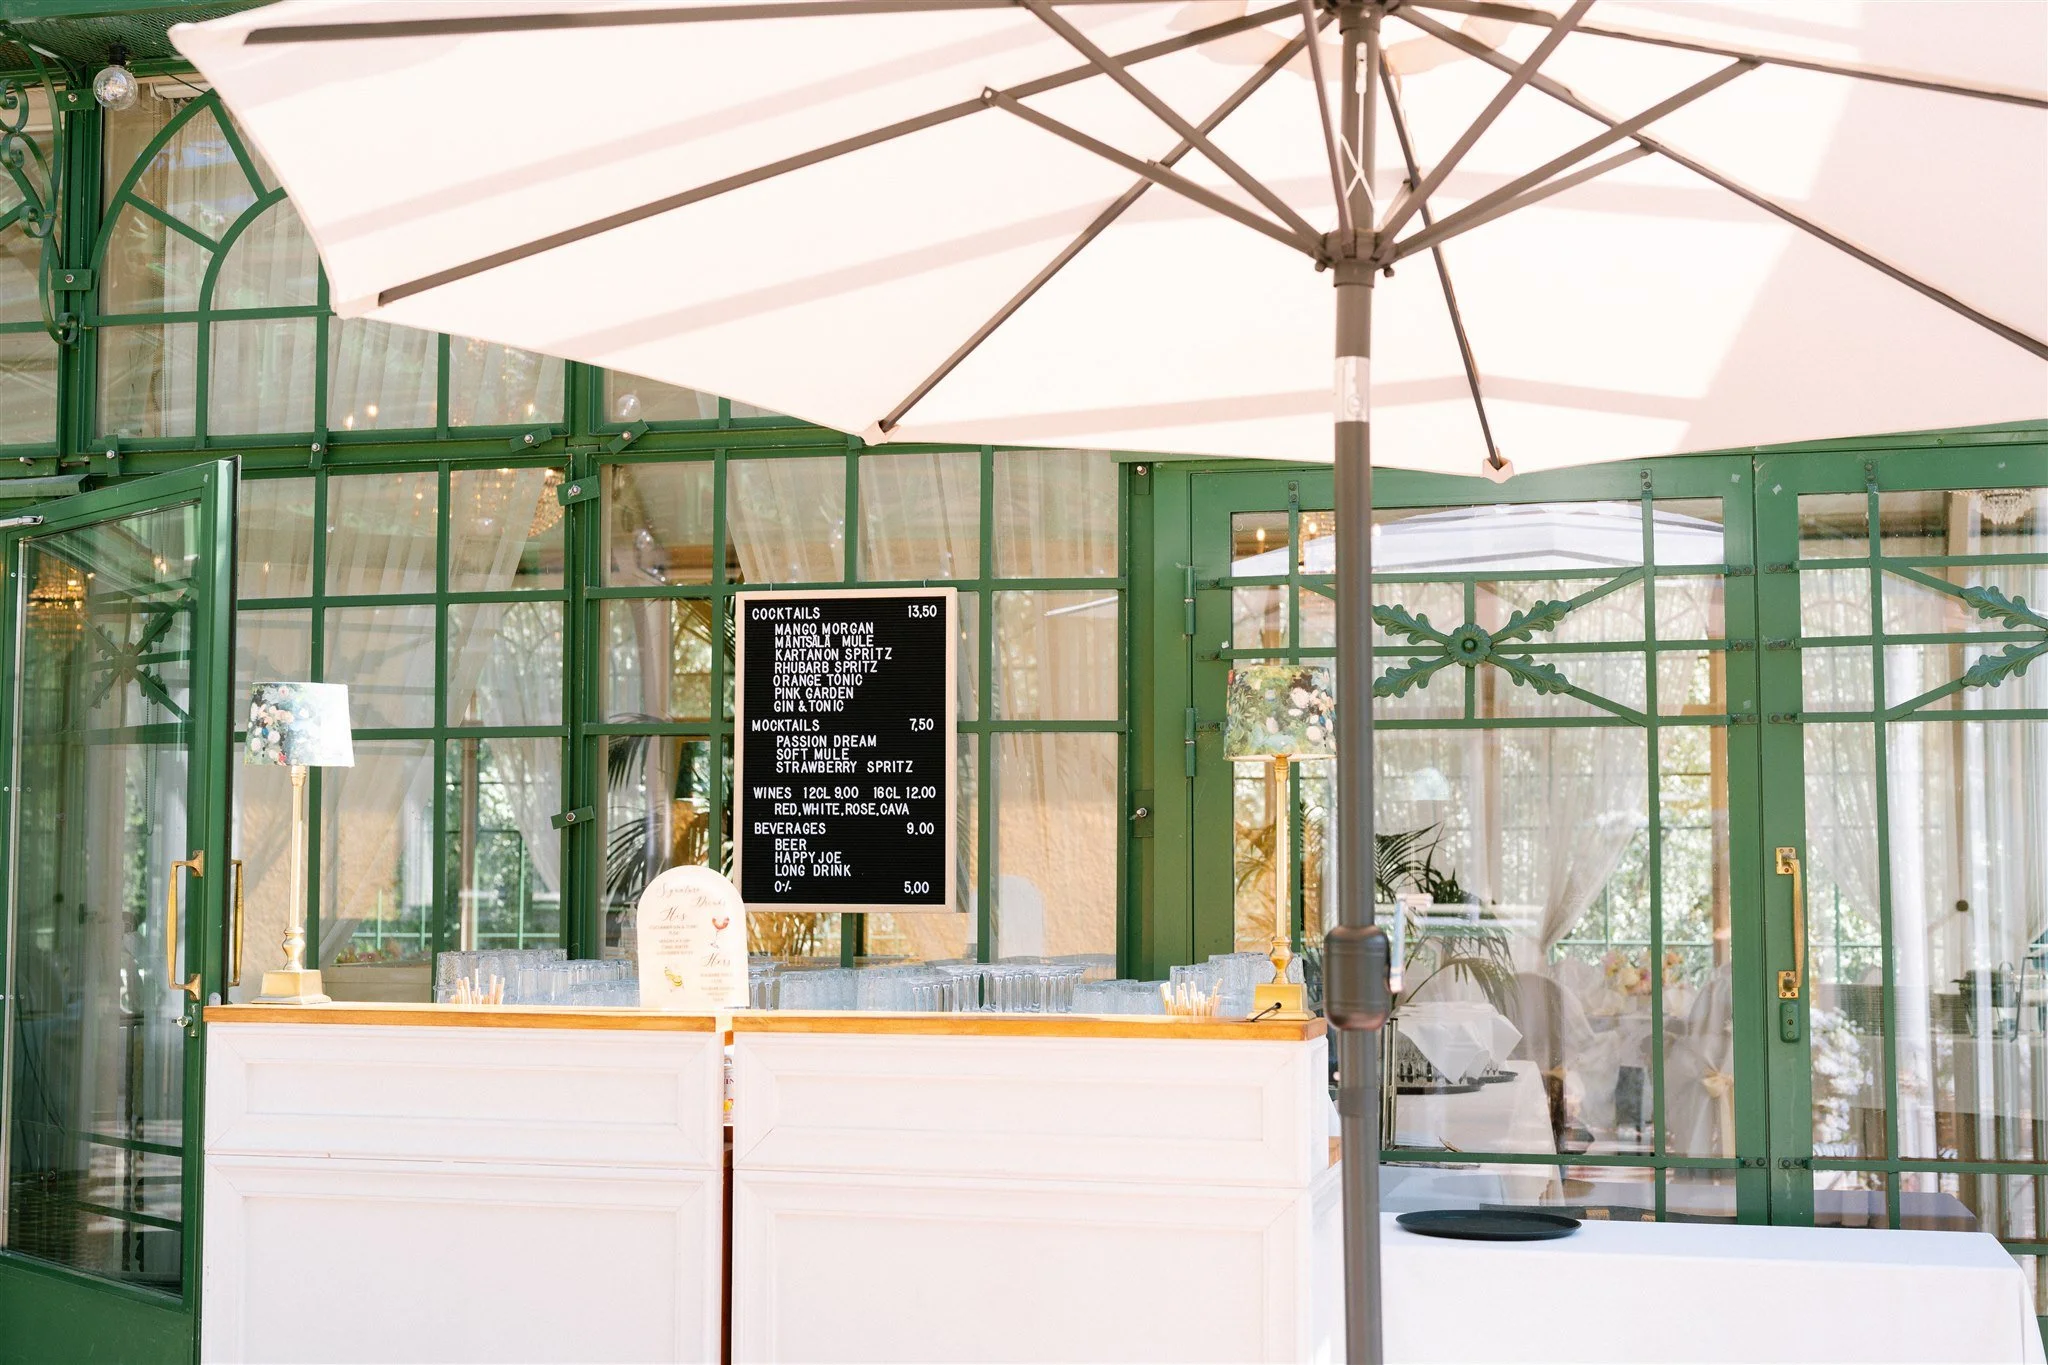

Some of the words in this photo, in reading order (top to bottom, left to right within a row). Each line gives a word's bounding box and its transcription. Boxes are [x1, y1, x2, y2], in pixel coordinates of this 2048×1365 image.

[752, 607, 820, 620] COCKTAILS
[908, 605, 937, 619] 13,50
[775, 624, 817, 635] MANGO
[822, 622, 874, 634] MORGAN
[842, 635, 874, 647] MULE
[775, 649, 839, 661] KARTANON
[845, 648, 892, 660] SPRITZ
[774, 662, 829, 673] RHUBARB
[834, 661, 877, 673] SPRITZ
[773, 675, 821, 686] ORANGE
[827, 674, 863, 686] TONIC
[775, 688, 801, 700] PINK
[806, 687, 854, 699] GARDEN
[774, 701, 795, 712] GIN
[799, 701, 807, 712] &
[808, 700, 844, 712] TONIC
[752, 719, 820, 732] MOCKTAILS
[910, 718, 934, 732] 7,50
[777, 736, 827, 747] PASSION
[834, 735, 876, 747] DREAM
[776, 749, 808, 761] SOFT
[814, 748, 849, 760] MULE
[776, 761, 857, 773] STRAWBERRY
[867, 761, 913, 773] SPRITZ
[754, 787, 792, 798] WINES
[803, 787, 830, 798] 12CL
[873, 787, 900, 798] 16CL
[754, 822, 826, 834] BEVERAGES
[775, 839, 807, 851] BEER
[775, 852, 816, 863] HAPPY
[818, 852, 842, 863] JOE
[775, 865, 805, 876] LONG
[813, 865, 851, 876] DRINK
[904, 881, 929, 895] 5,00
[660, 905, 686, 922] His
[701, 952, 730, 968] Hers
